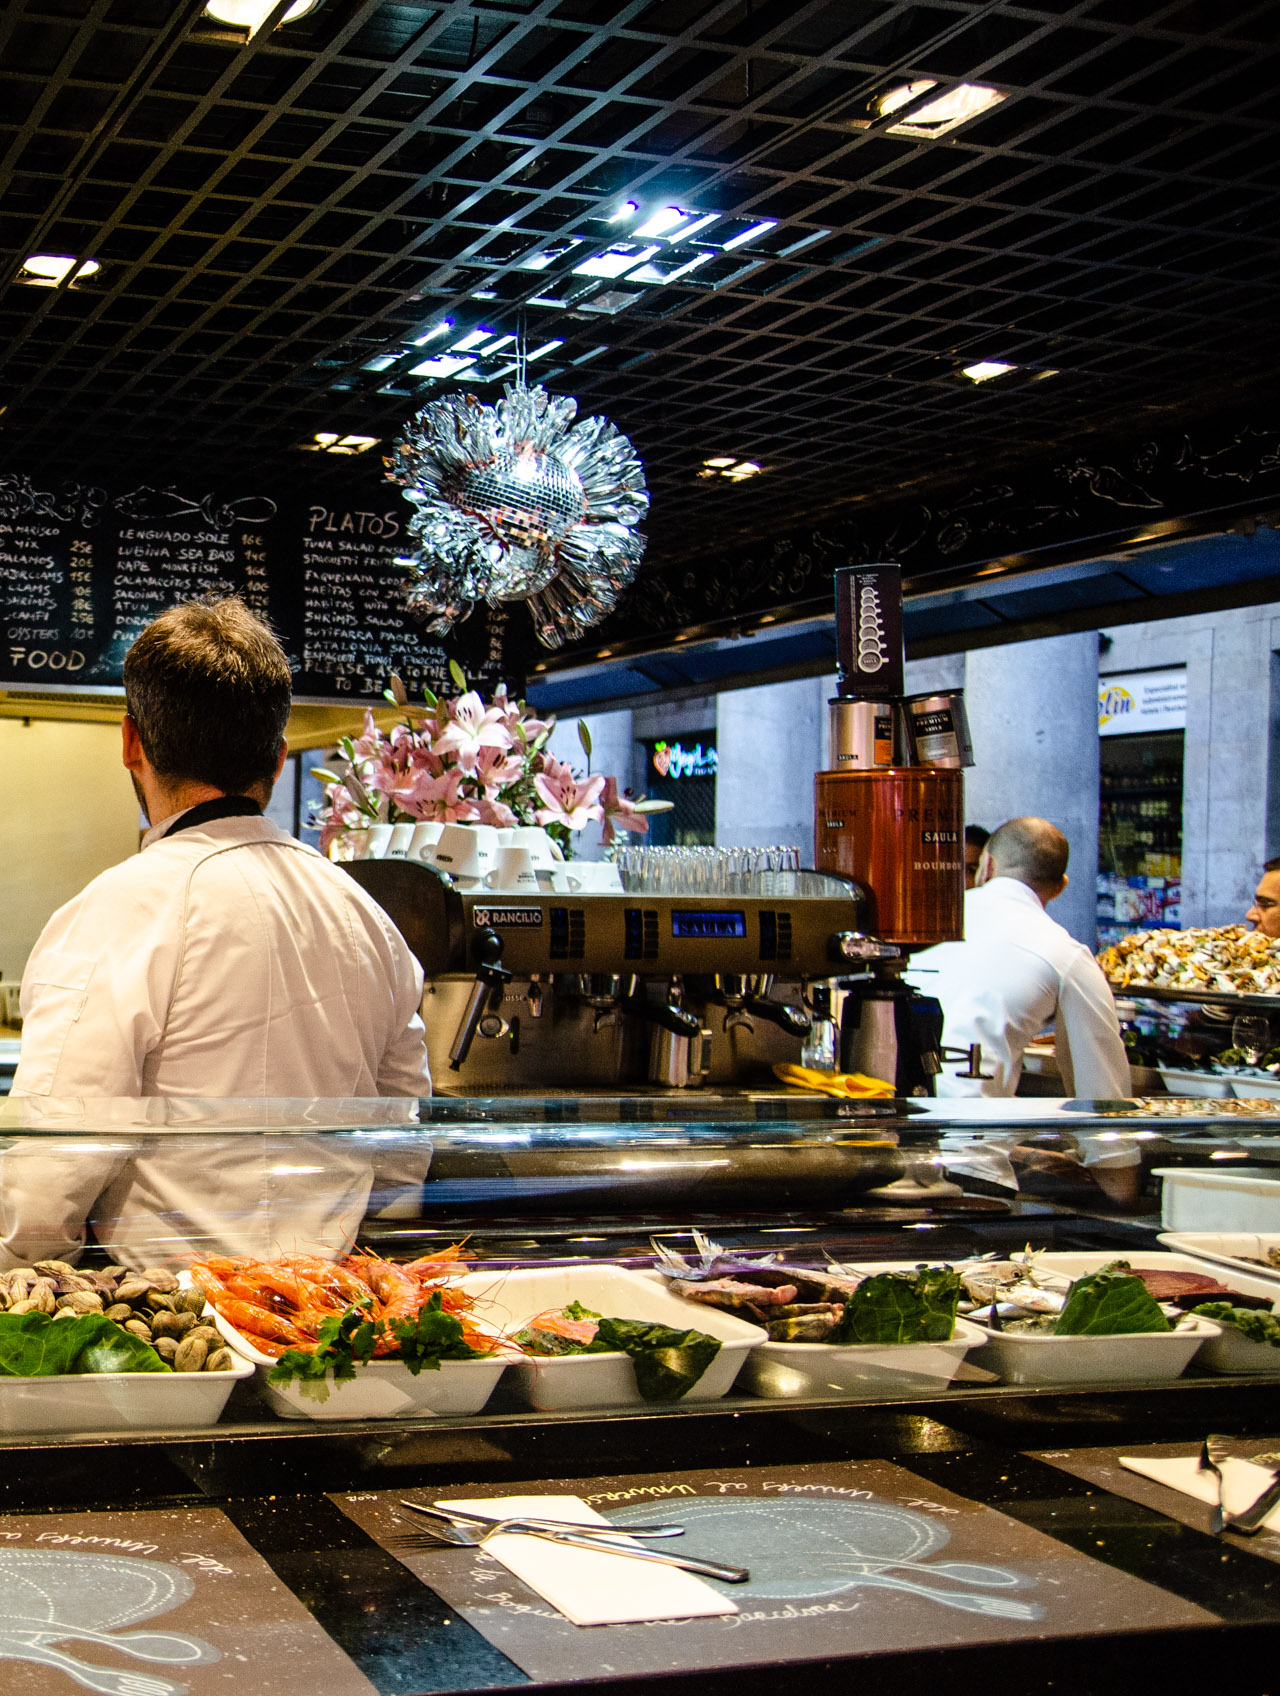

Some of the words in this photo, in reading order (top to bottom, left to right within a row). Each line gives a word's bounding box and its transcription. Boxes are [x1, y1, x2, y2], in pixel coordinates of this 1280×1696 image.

[309, 505, 400, 539] PLATOS
[303, 537, 334, 551] TUNA
[338, 541, 375, 553] SALAD
[117, 543, 170, 558] LUBINA
[208, 549, 235, 562] BASS
[70, 557, 94, 569] 20€
[117, 560, 151, 573] RAPE
[70, 571, 93, 583] 15€
[8, 584, 51, 597] CLAMS
[114, 600, 149, 611] ATUN
[115, 615, 155, 626] DORA
[363, 616, 404, 628] SALAD
[7, 627, 59, 640] OYSTERS
[304, 627, 374, 641] BUTIFARRA
[304, 641, 382, 654] CATALONIA
[9, 647, 86, 671] FOOD
[304, 660, 366, 676] PLEASE
[335, 677, 352, 691] TO
[360, 680, 384, 694] BE
[402, 681, 463, 695] EATED
[923, 832, 958, 843] SAULA
[492, 911, 542, 923] RANCILIO
[36, 1531, 159, 1557] Univers
[474, 1592, 570, 1622] Boque
